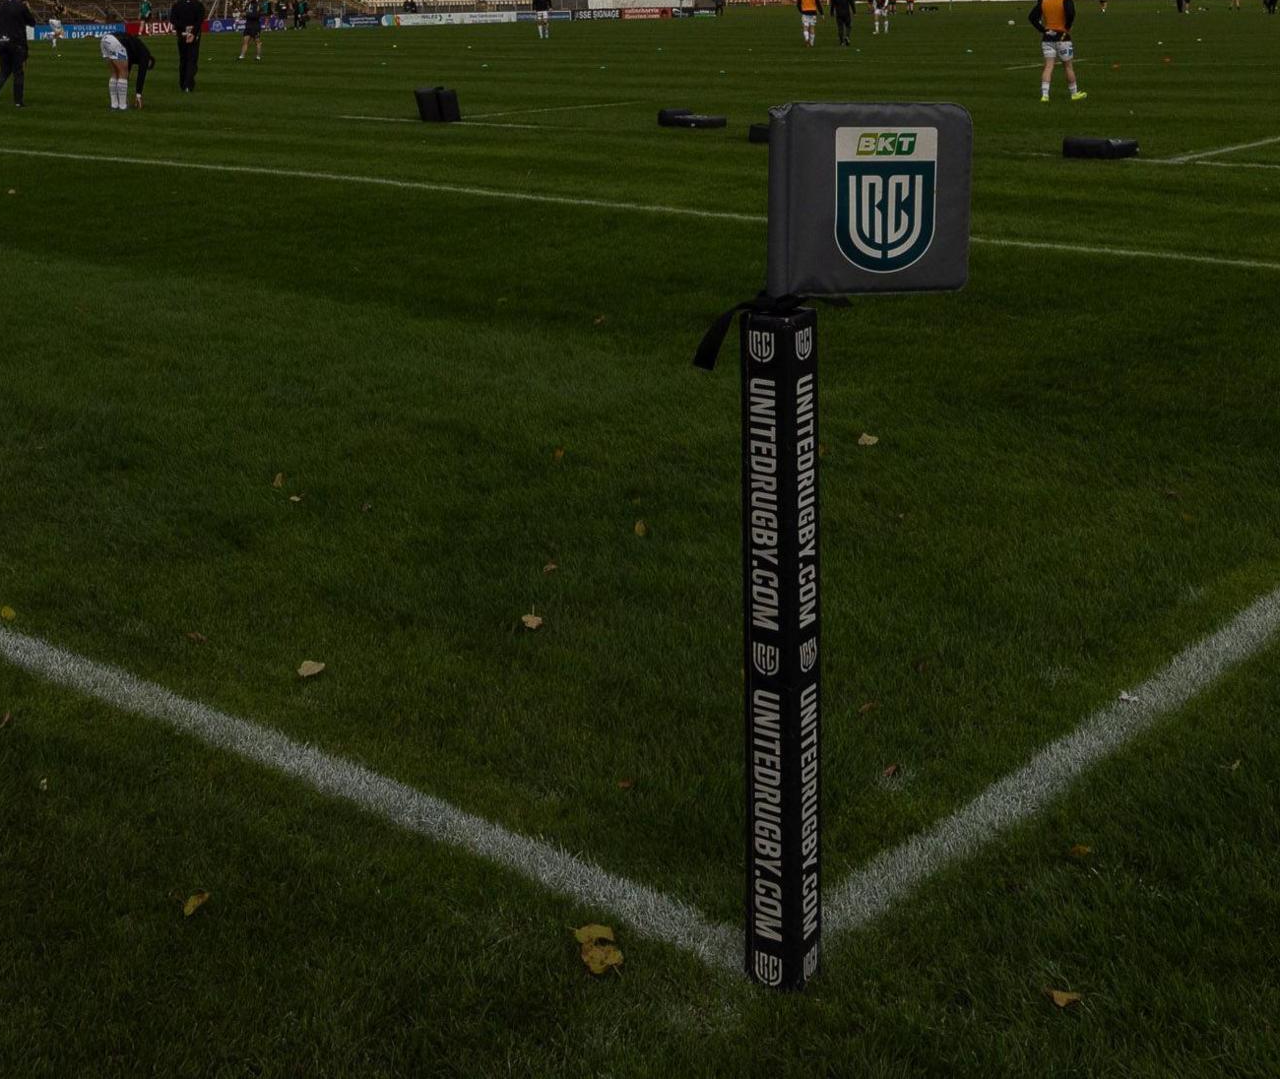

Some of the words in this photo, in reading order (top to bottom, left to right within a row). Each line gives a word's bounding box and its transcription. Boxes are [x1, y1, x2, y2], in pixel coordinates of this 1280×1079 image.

[857, 135, 916, 153] BKT
[749, 377, 780, 631] UNITEDRUGBY.COM
[796, 373, 817, 629] UNITEDRUGBY.COM
[753, 688, 782, 942] UNITEDRUGBY.COM
[800, 682, 817, 941] UNITEDRUGBY.COM
